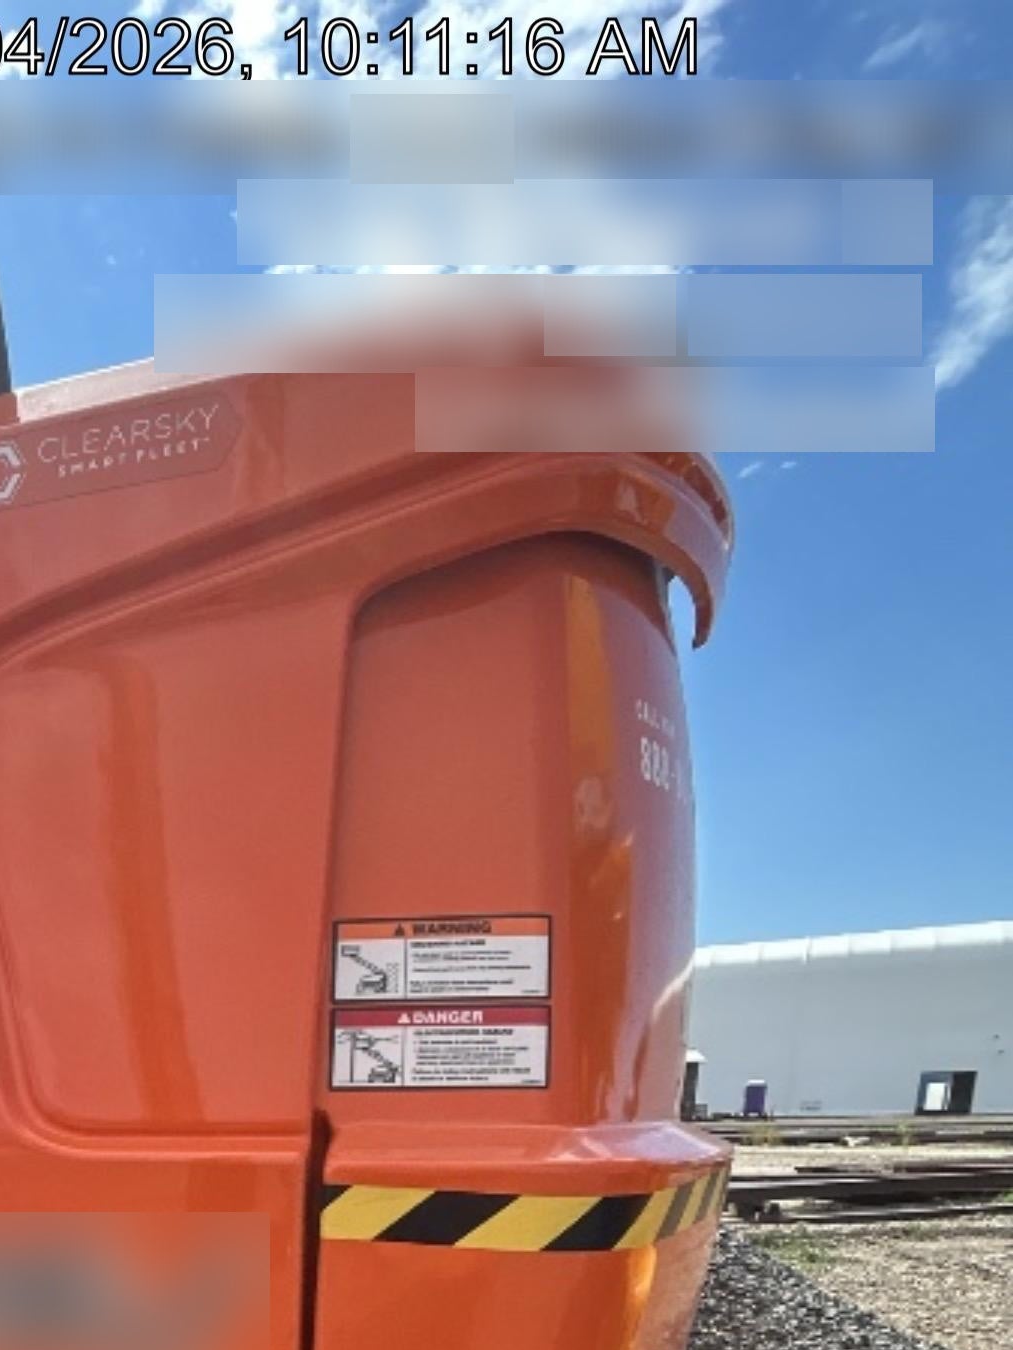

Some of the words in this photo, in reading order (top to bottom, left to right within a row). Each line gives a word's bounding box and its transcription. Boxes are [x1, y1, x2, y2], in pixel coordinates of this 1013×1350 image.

[37, 403, 219, 463] CLEARSKY
[58, 452, 127, 477] SMART
[412, 1010, 484, 1024] DANGER
